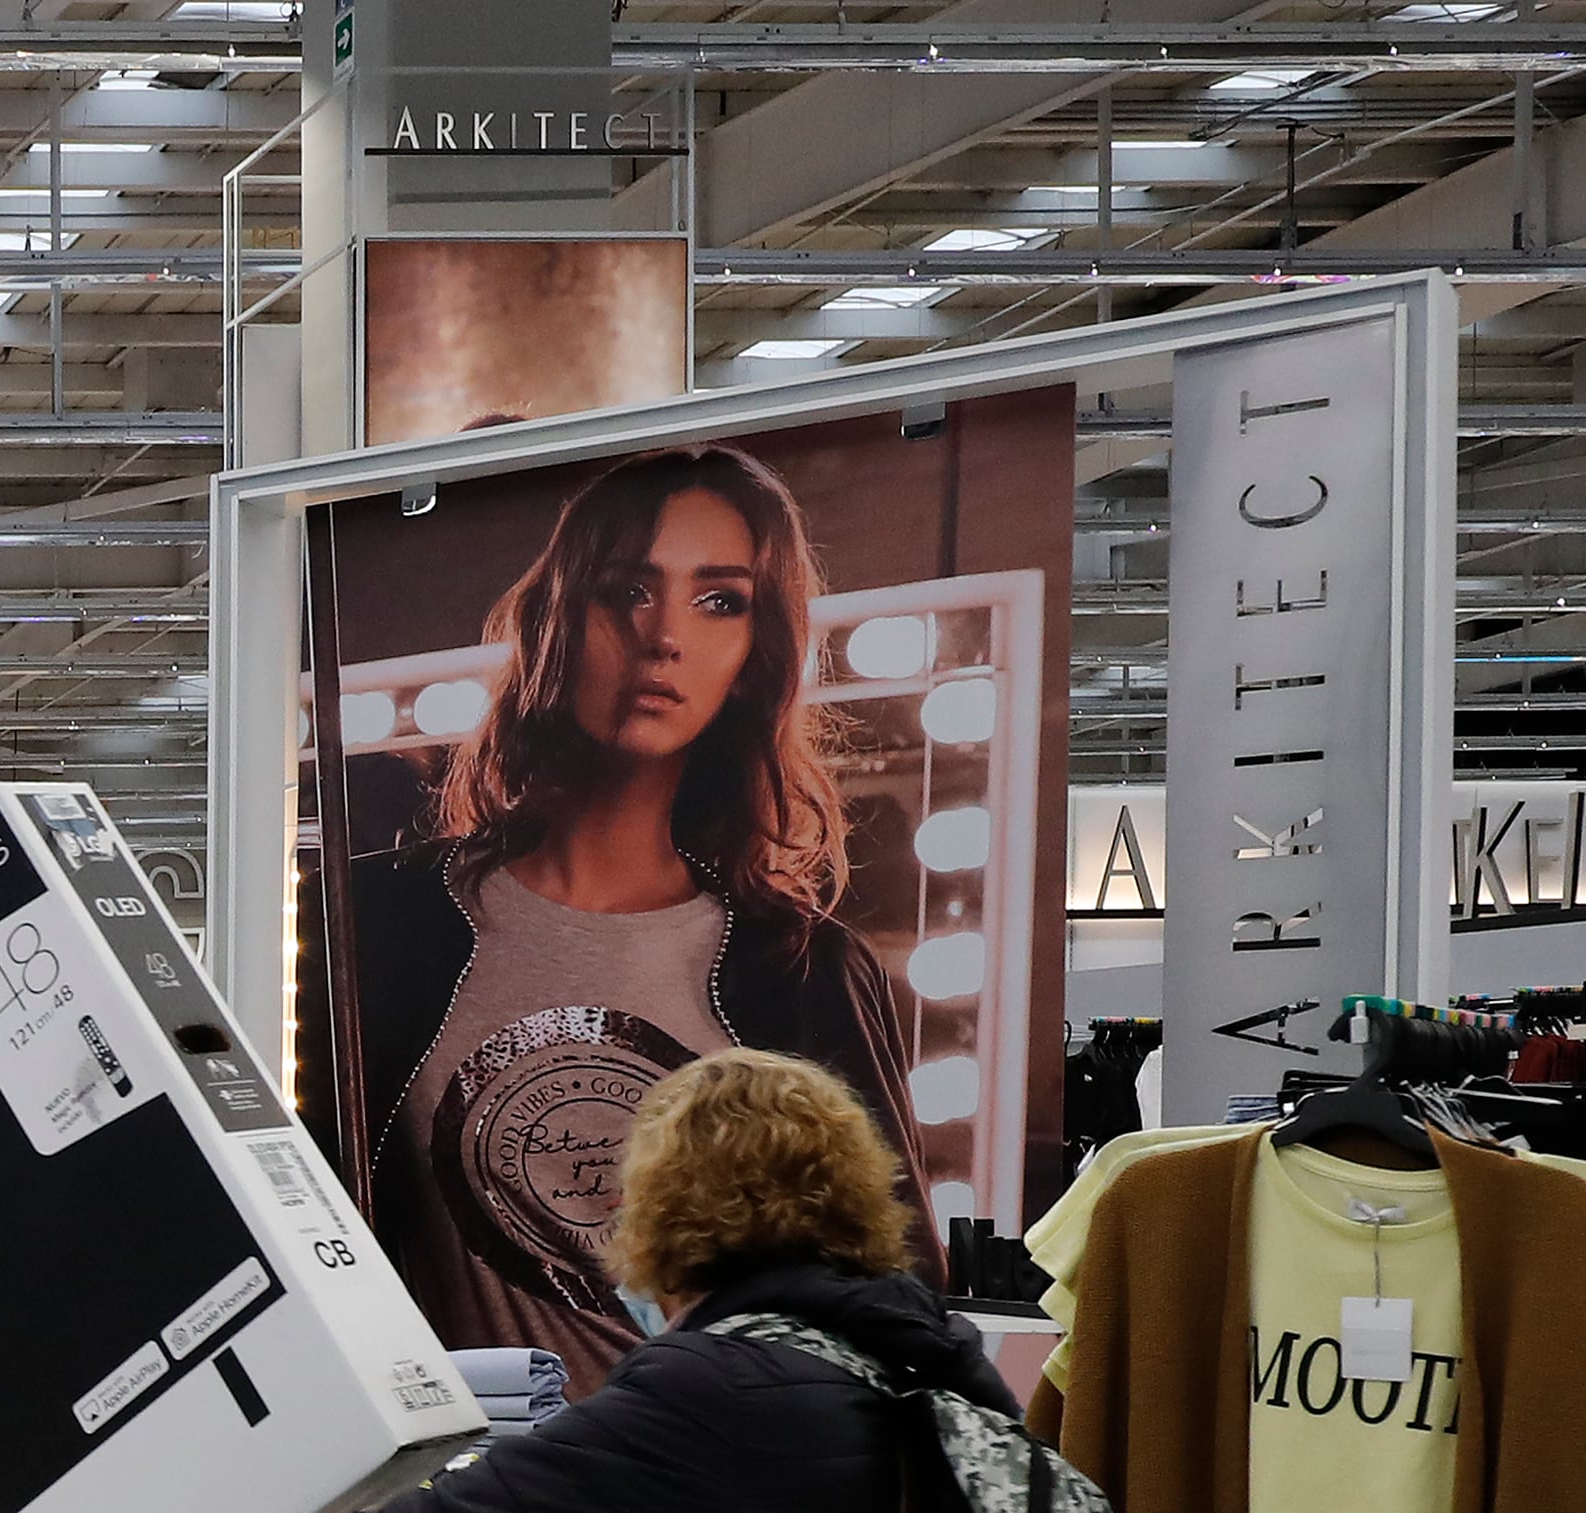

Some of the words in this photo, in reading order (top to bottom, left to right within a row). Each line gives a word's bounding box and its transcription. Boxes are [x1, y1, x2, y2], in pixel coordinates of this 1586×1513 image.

[393, 105, 665, 151] ARKITECT
[1211, 388, 1331, 1056] ARKITECT
[94, 897, 147, 917] OLED
[518, 1122, 624, 1154] Betwe
[552, 1174, 611, 1200] and
[314, 1238, 356, 1269] CB
